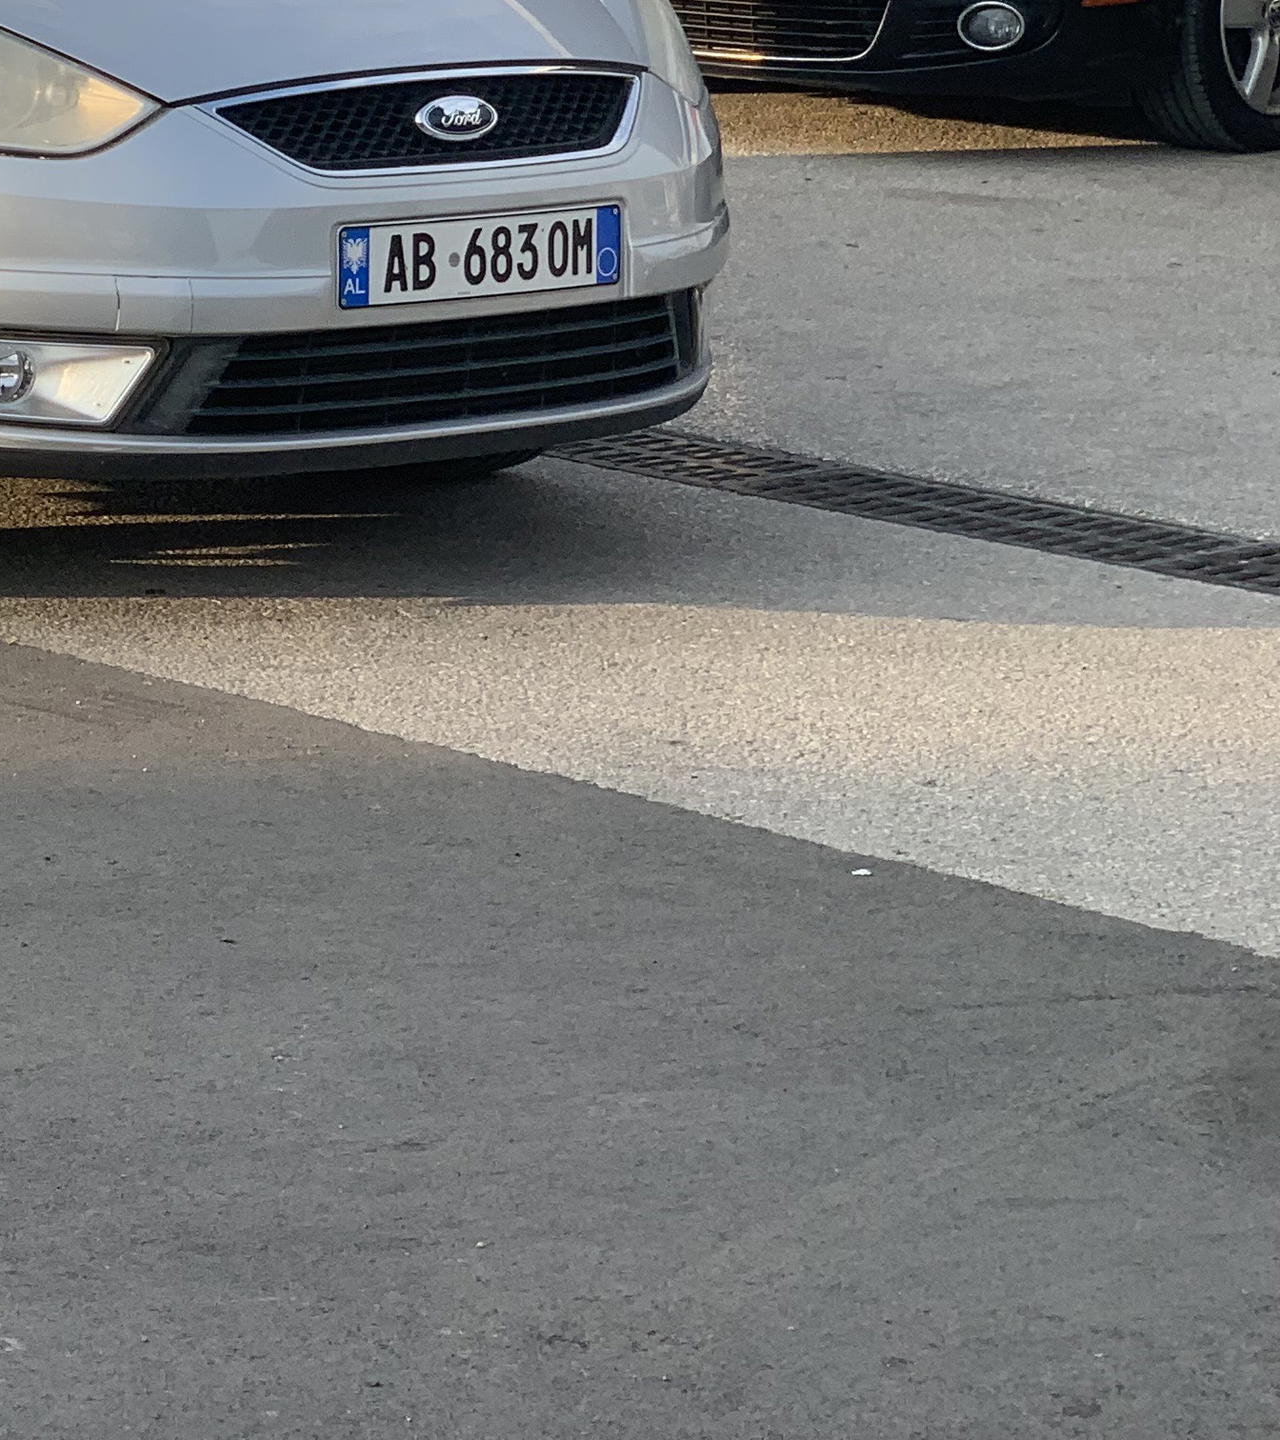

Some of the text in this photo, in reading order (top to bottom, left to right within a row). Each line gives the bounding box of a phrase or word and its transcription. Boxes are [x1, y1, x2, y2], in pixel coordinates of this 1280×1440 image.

[440, 106, 483, 128] Ford
[383, 232, 437, 294] AB
[463, 223, 539, 286] 683
[343, 280, 366, 296] AL
